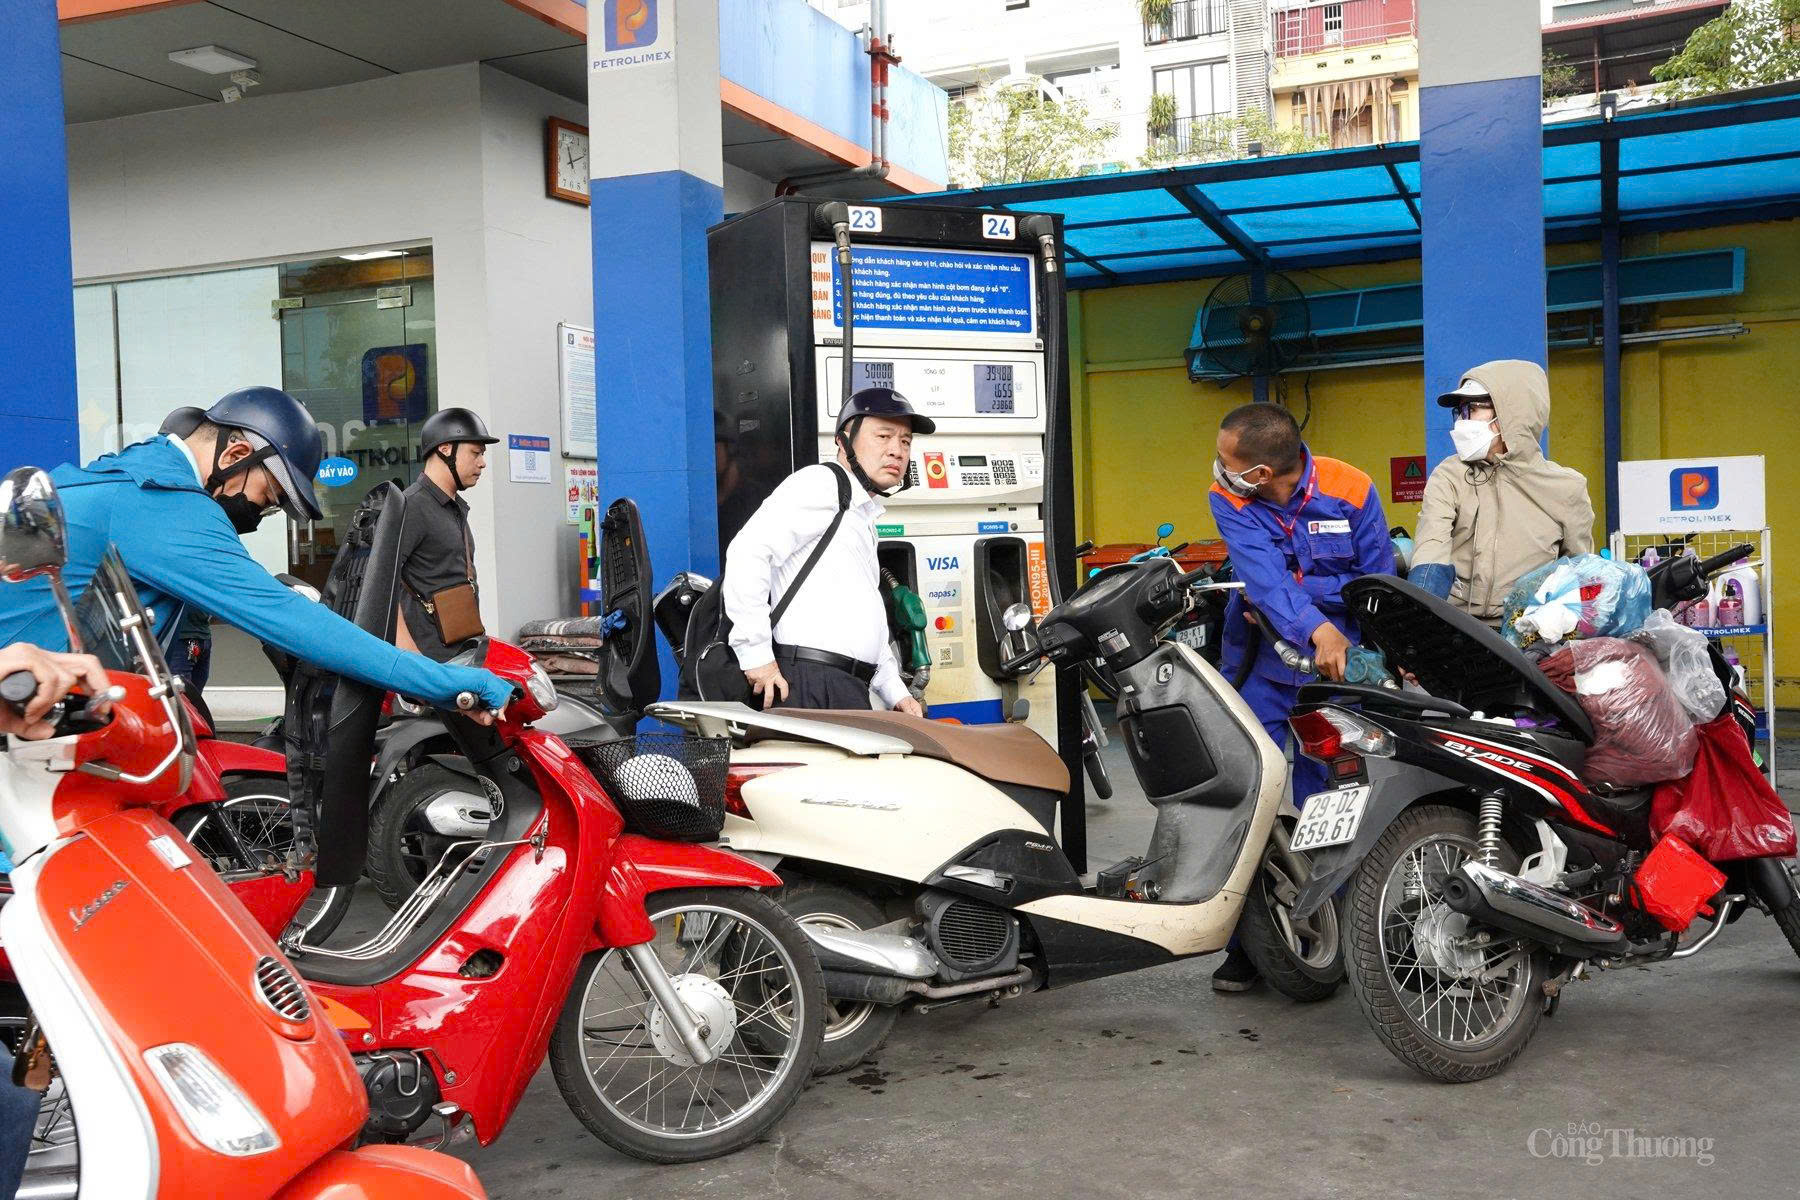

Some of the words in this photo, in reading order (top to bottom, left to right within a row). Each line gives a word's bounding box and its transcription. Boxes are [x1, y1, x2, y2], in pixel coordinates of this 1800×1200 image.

[593, 51, 671, 69] PETROLIMEX
[852, 210, 876, 228] 23
[987, 218, 1011, 237] 24
[812, 253, 827, 264] QUY
[336, 465, 354, 477] VÀO
[1659, 514, 1732, 524] PETROLIMEX
[927, 556, 959, 571] VISA
[1030, 549, 1041, 609] RON95-III
[928, 590, 951, 600] napas
[1699, 628, 1751, 636] PETROLIMEX
[1444, 740, 1534, 772] BLADE
[1308, 790, 1359, 820] 29-D2
[1294, 815, 1355, 847] 659.61
